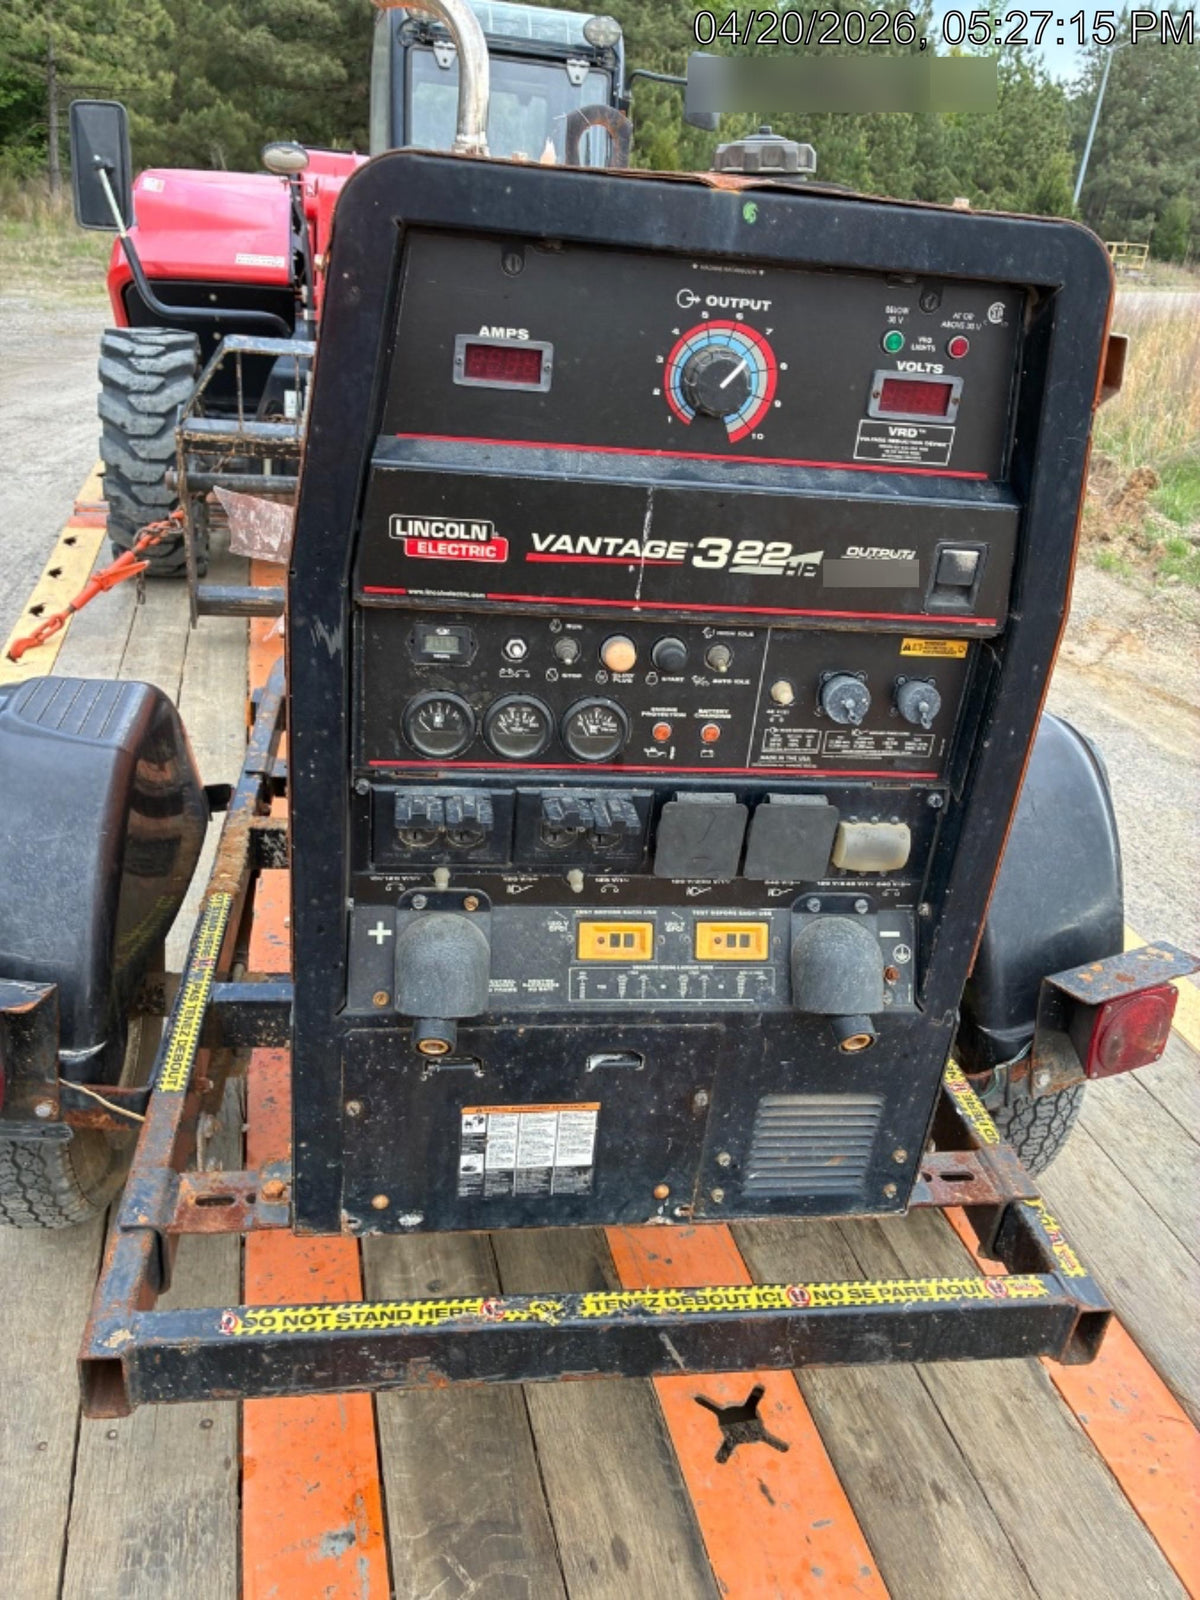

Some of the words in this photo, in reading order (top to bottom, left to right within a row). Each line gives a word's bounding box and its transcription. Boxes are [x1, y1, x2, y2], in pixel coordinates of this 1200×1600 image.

[705, 294, 772, 311] OUTPUT
[478, 325, 529, 340] AMPS
[896, 361, 944, 374] VOLTS
[396, 519, 488, 541] LINCOLN
[417, 541, 497, 558] ELECTRIC
[531, 533, 689, 560] VANTAGE
[691, 536, 793, 569] 322
[408, 589, 486, 599] www.lincolnelectric.com
[179, 1004, 198, 1038] TENEZ
[167, 1039, 188, 1087] DEBOUT
[666, 1293, 751, 1306] DEBOUT
[756, 1291, 783, 1302] ICI
[813, 1288, 843, 1300] NO
[848, 1287, 875, 1299] SE
[879, 1286, 931, 1298] PARE
[282, 1312, 329, 1327] NOT
[336, 1308, 411, 1325] STAND
